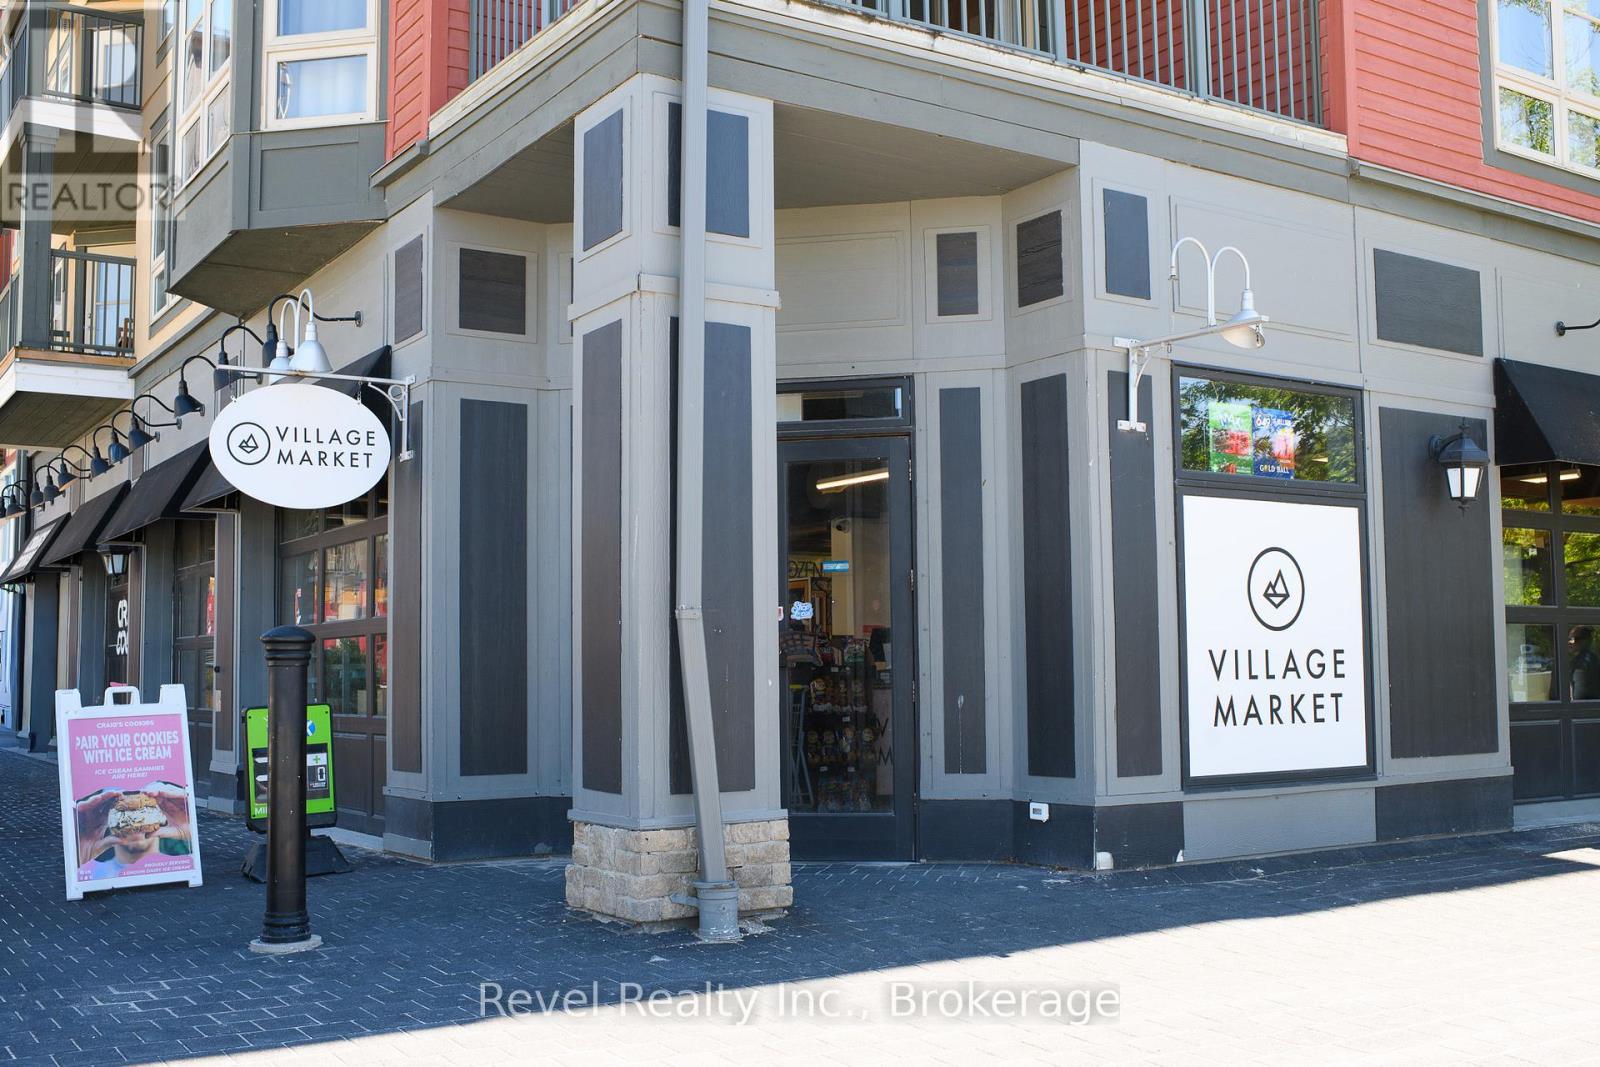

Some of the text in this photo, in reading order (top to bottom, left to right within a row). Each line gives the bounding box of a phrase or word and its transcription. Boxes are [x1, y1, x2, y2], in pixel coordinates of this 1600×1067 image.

[276, 426, 375, 446] VILLAGE
[277, 449, 372, 468] MARKET
[1208, 648, 1345, 681] VILLAGE
[1213, 693, 1343, 727] MARKET
[102, 734, 131, 748] YOUR
[133, 731, 179, 746] COOKIES
[83, 745, 172, 764] WITH ICE CREAM
[108, 767, 132, 775] CREAM
